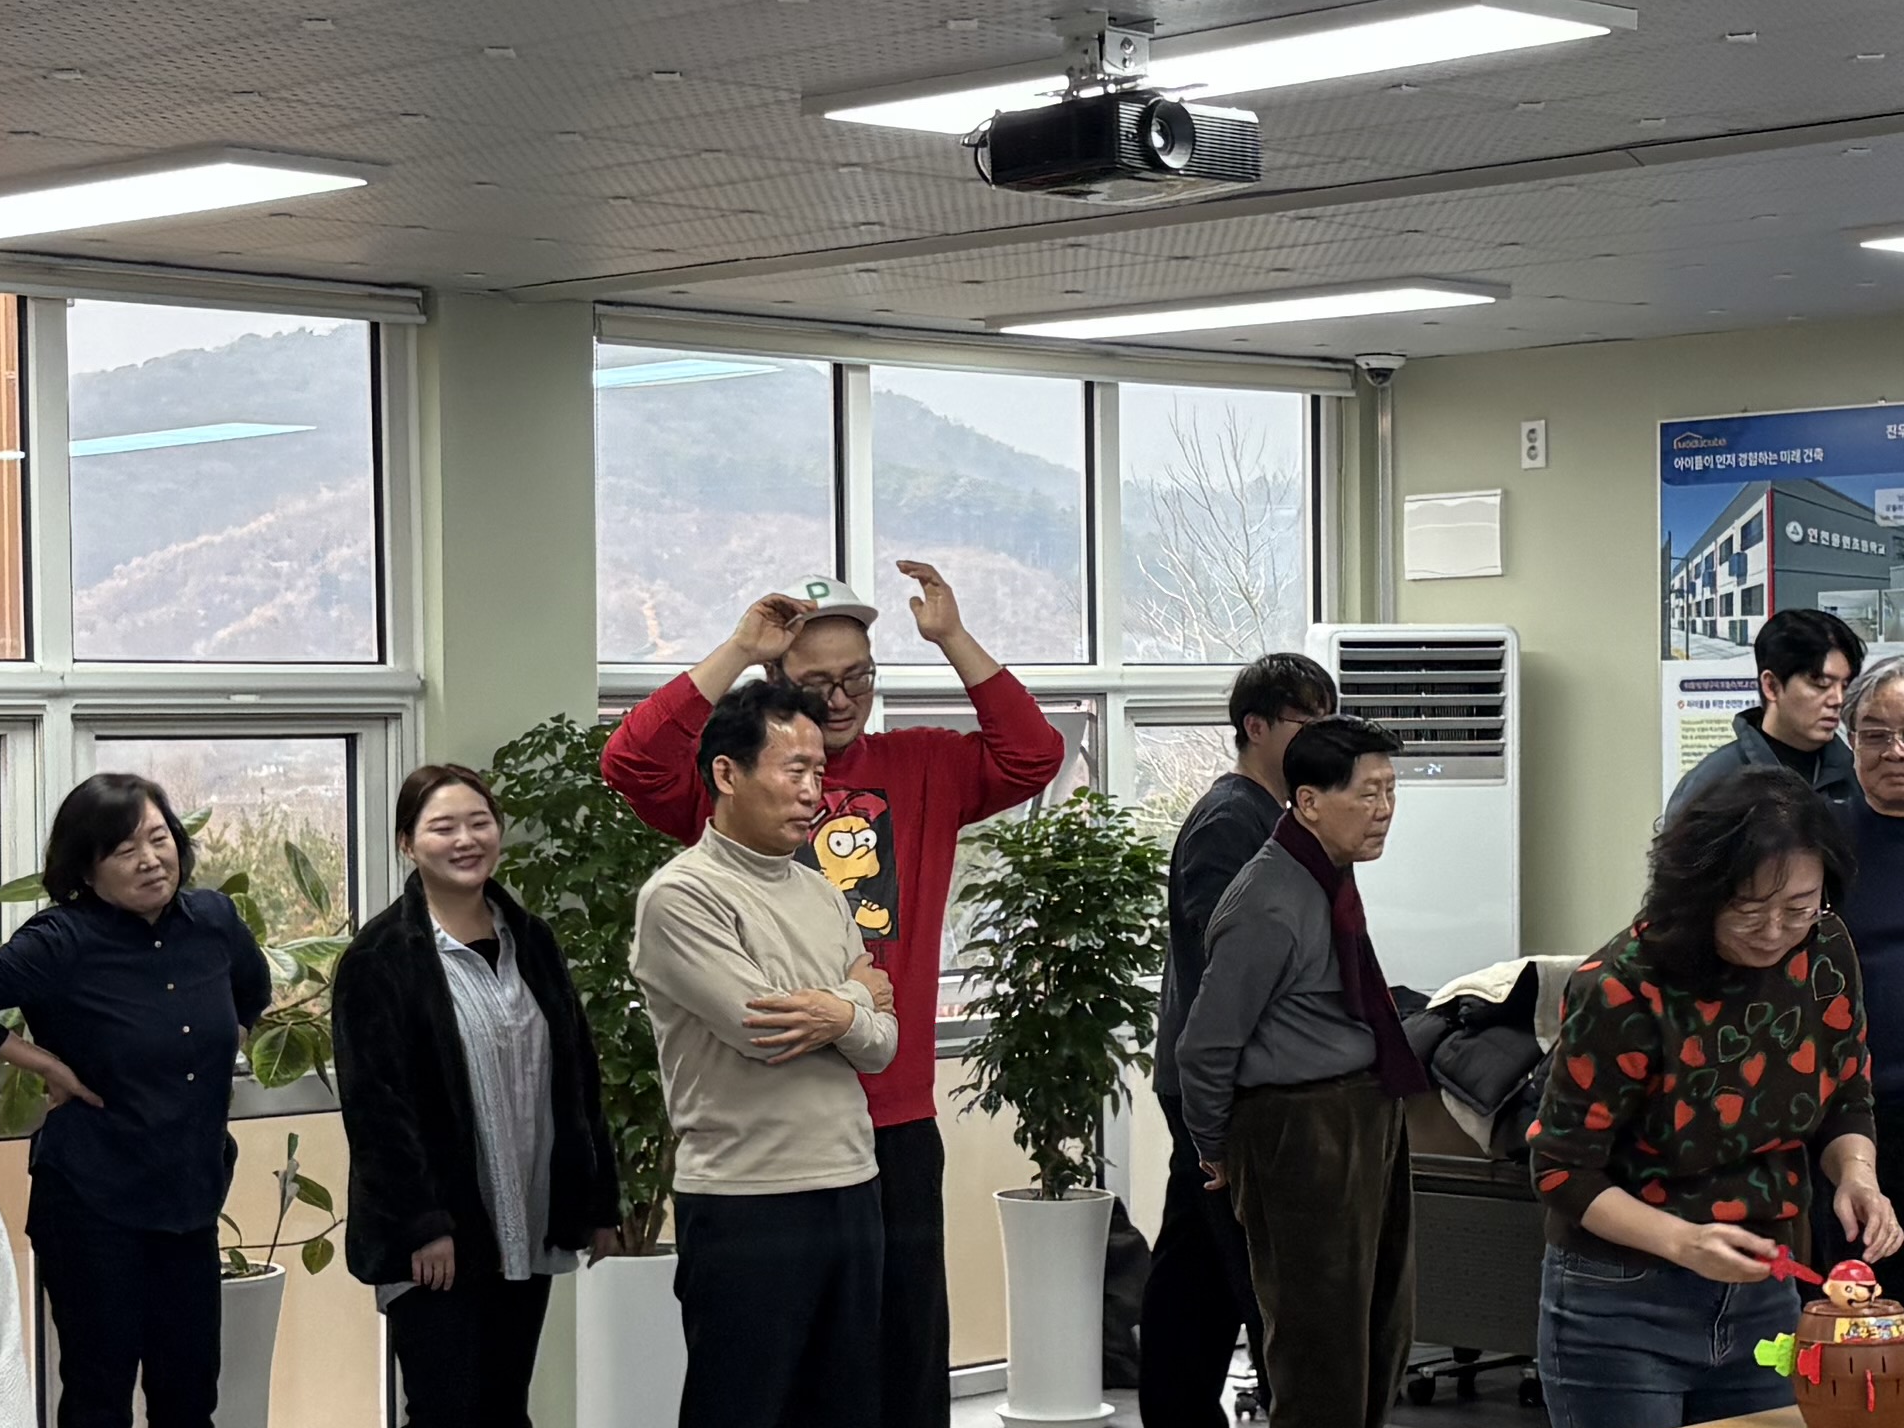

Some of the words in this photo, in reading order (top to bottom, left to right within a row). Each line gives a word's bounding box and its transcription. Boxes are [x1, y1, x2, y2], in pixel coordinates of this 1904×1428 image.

[1674, 454, 1715, 471] 아이들이
[1738, 451, 1778, 467] 경험하는
[1779, 448, 1801, 463] 미래
[1802, 447, 1824, 462] 건축
